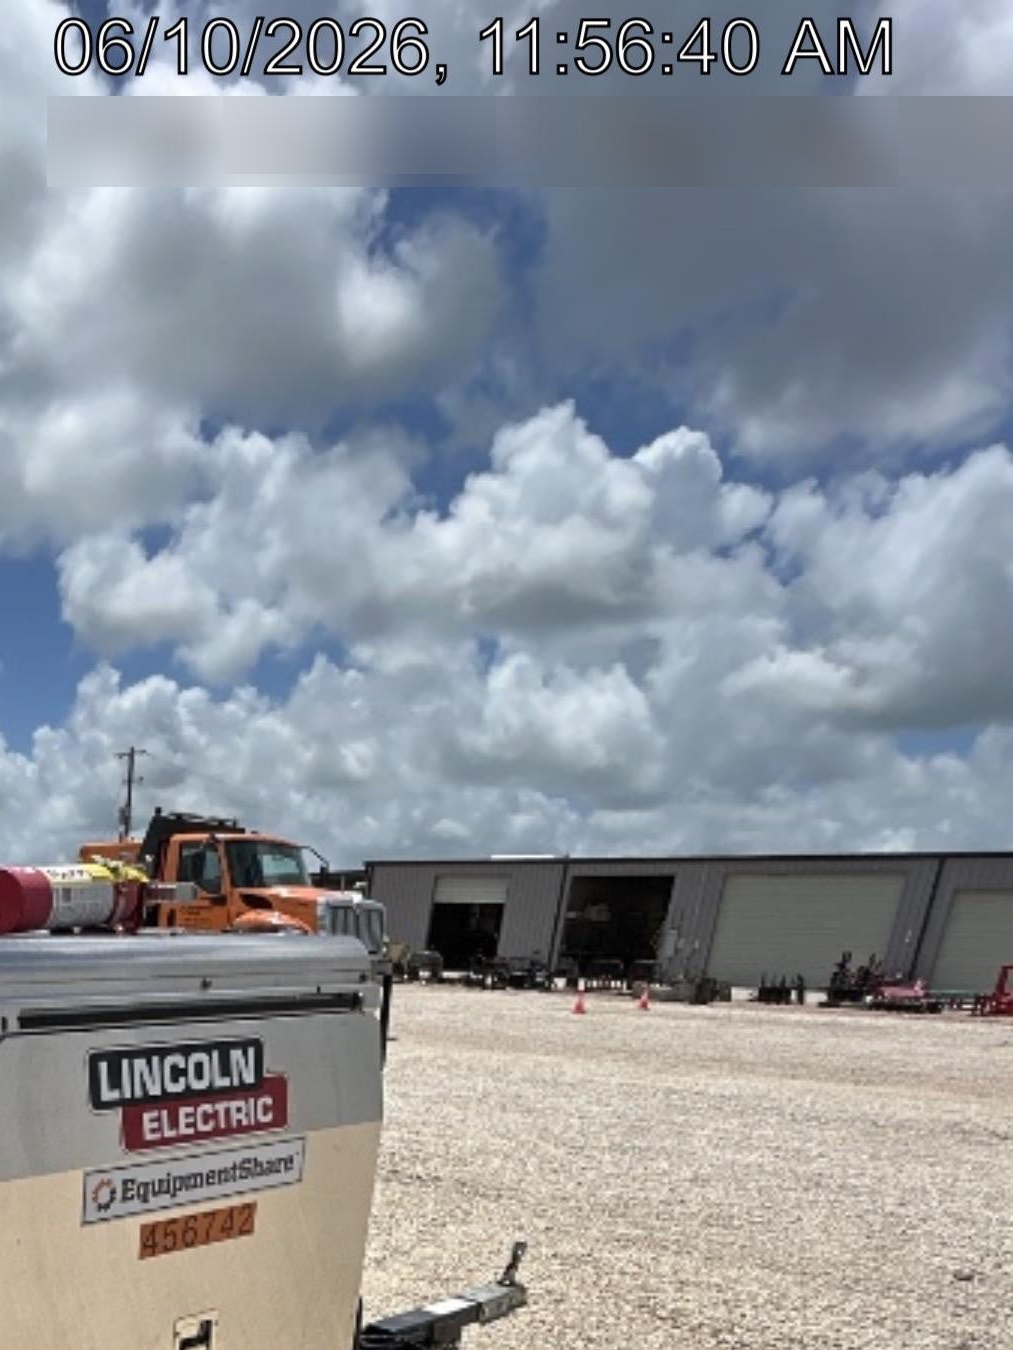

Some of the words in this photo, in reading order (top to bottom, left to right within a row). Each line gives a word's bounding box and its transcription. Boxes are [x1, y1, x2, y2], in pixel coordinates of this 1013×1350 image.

[98, 1046, 256, 1102] LINCOLN
[142, 1096, 274, 1141] ELECTRIC
[120, 1156, 295, 1204] EquipmentShare
[142, 1203, 254, 1257] 456742
